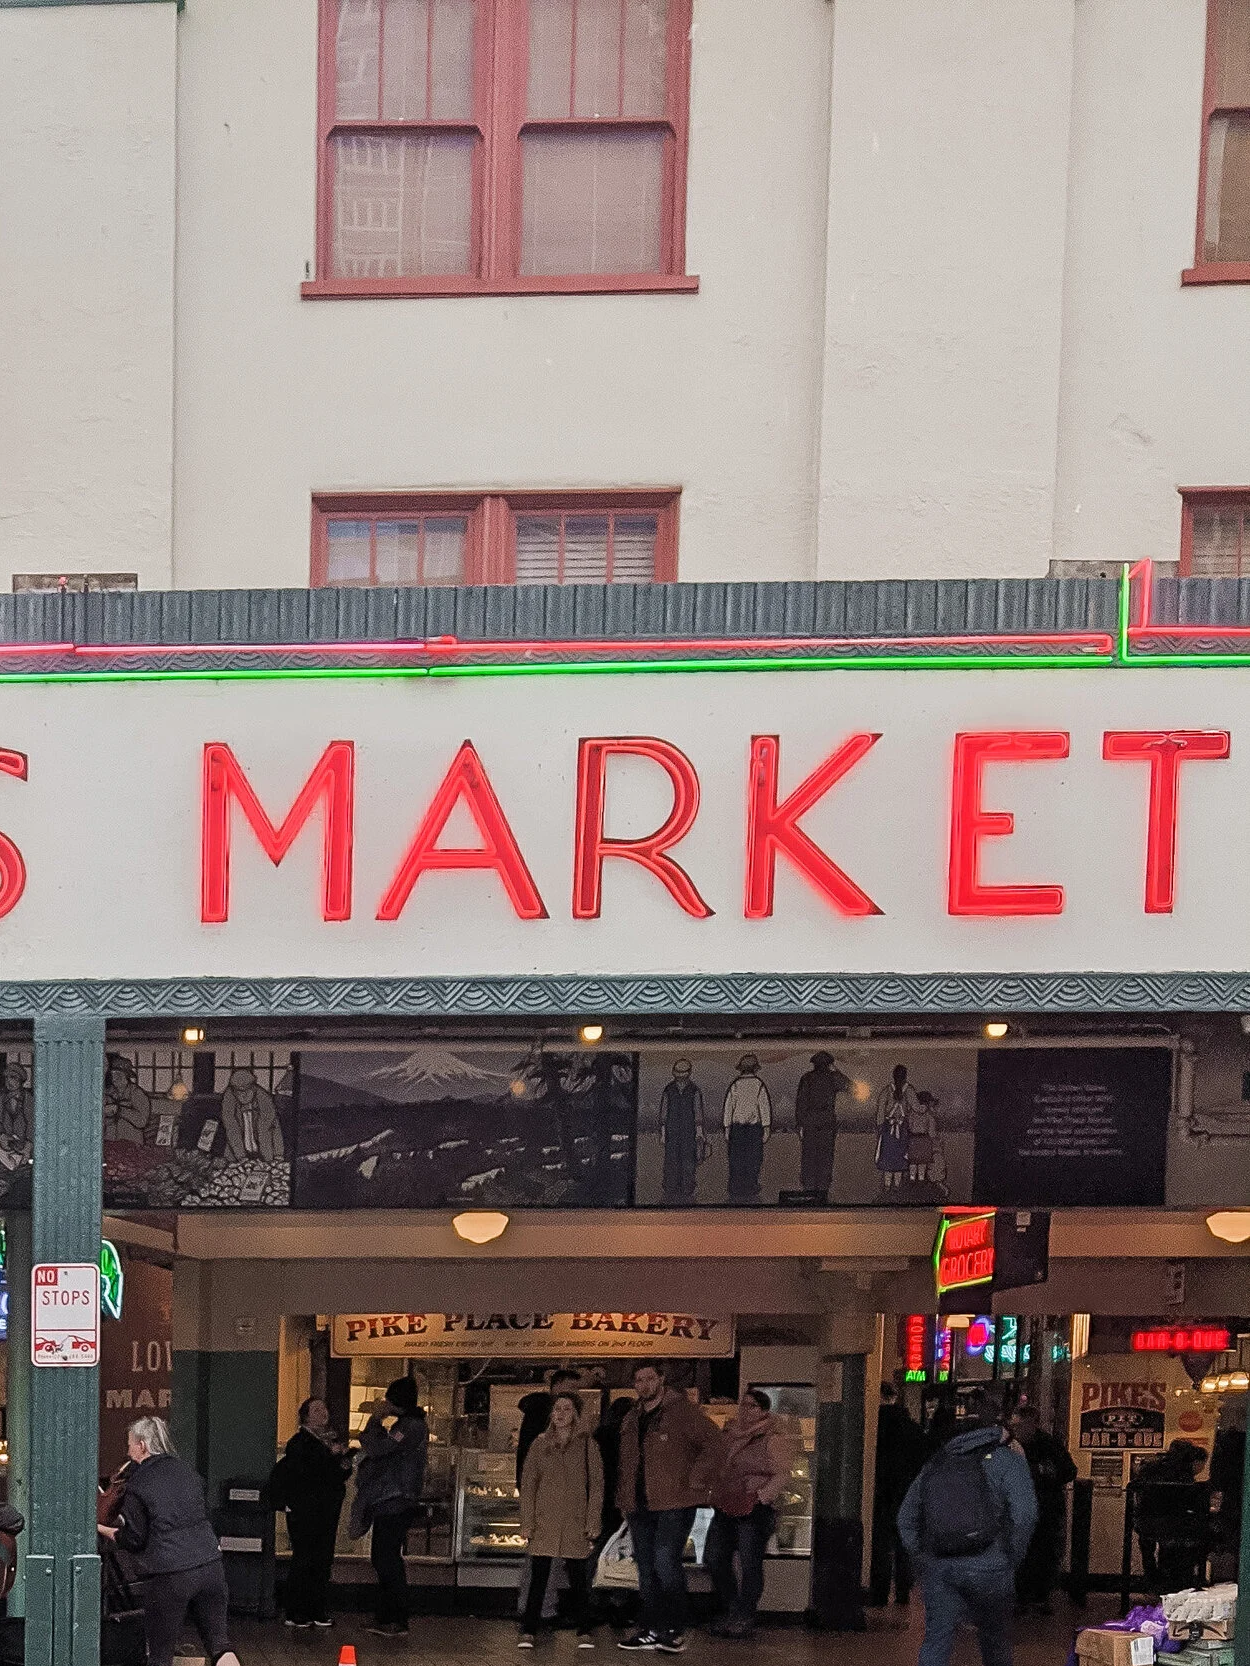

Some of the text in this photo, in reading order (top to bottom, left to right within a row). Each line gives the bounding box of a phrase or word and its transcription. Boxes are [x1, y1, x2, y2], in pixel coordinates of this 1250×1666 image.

[200, 730, 1232, 925] MARKET
[940, 1248, 994, 1286] GROCERY
[37, 1270, 55, 1283] NO
[42, 1290, 90, 1306] STOPS
[346, 1313, 719, 1342] PIKE PLACE BAKERY
[1136, 1332, 1226, 1350] BAR-B-QUE
[905, 1370, 926, 1382] ATM
[1081, 1382, 1167, 1412] PIKES
[1081, 1432, 1163, 1448] BAR-B-QUE
